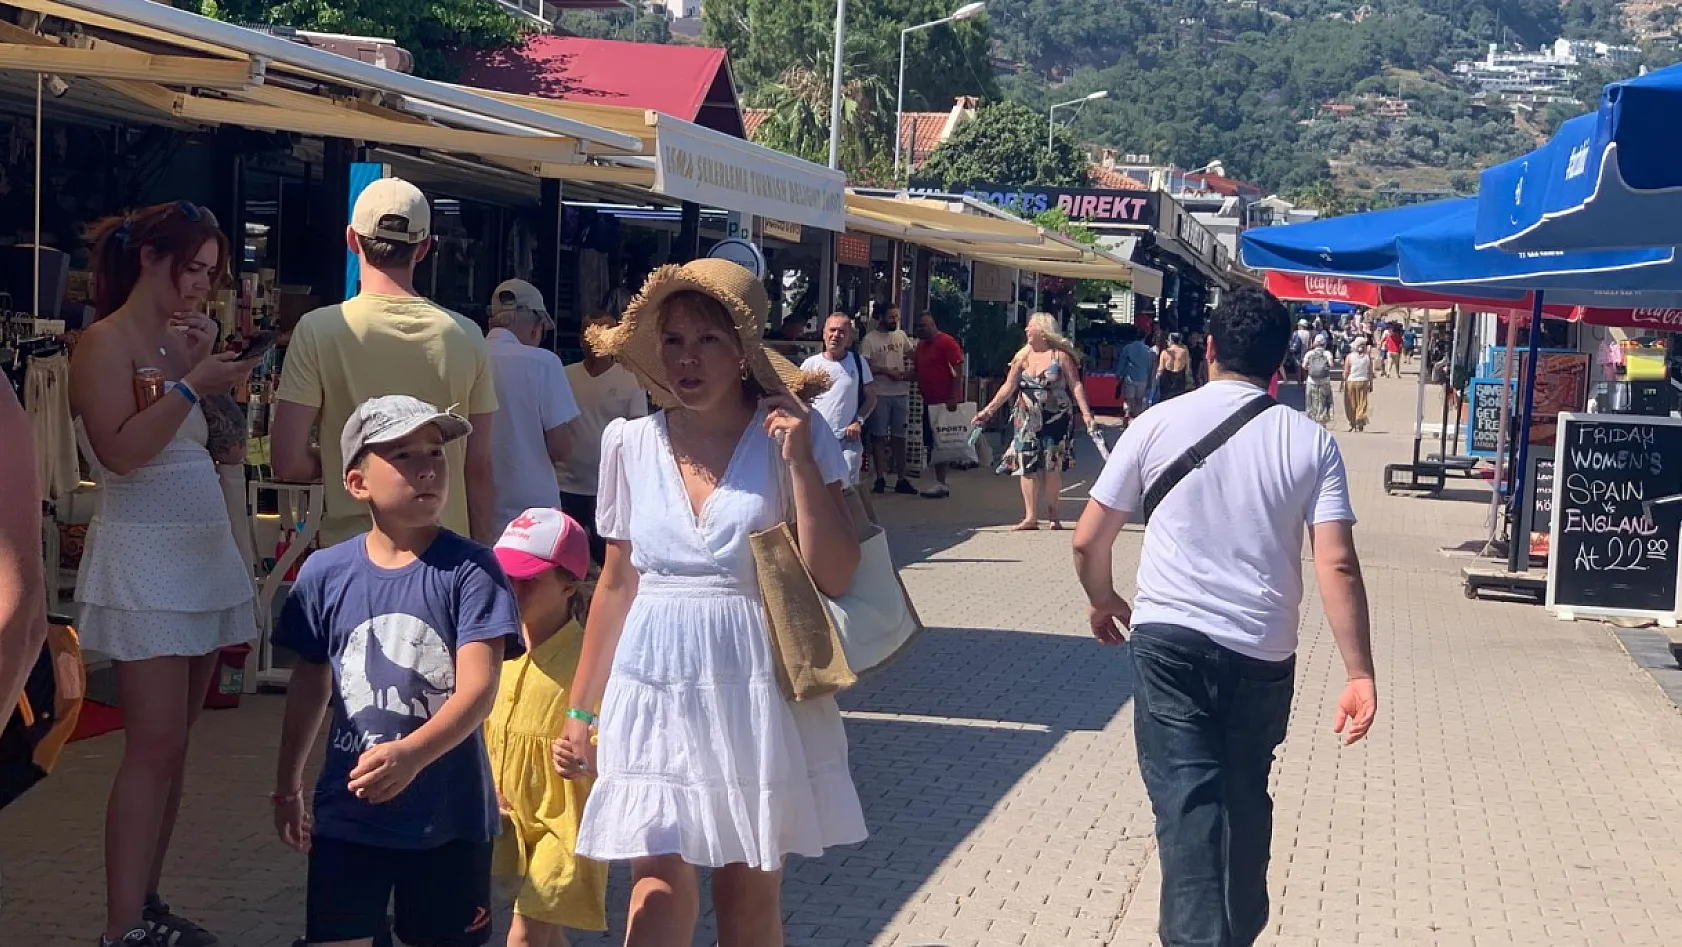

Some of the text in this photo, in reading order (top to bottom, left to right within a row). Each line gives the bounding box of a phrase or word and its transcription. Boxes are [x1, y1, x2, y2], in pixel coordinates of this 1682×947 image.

[1057, 195, 1147, 219] DIREKT
[1574, 422, 1654, 450] FRIDAY
[1571, 447, 1662, 475] WOMEN'S
[1566, 473, 1644, 505] SPAIN
